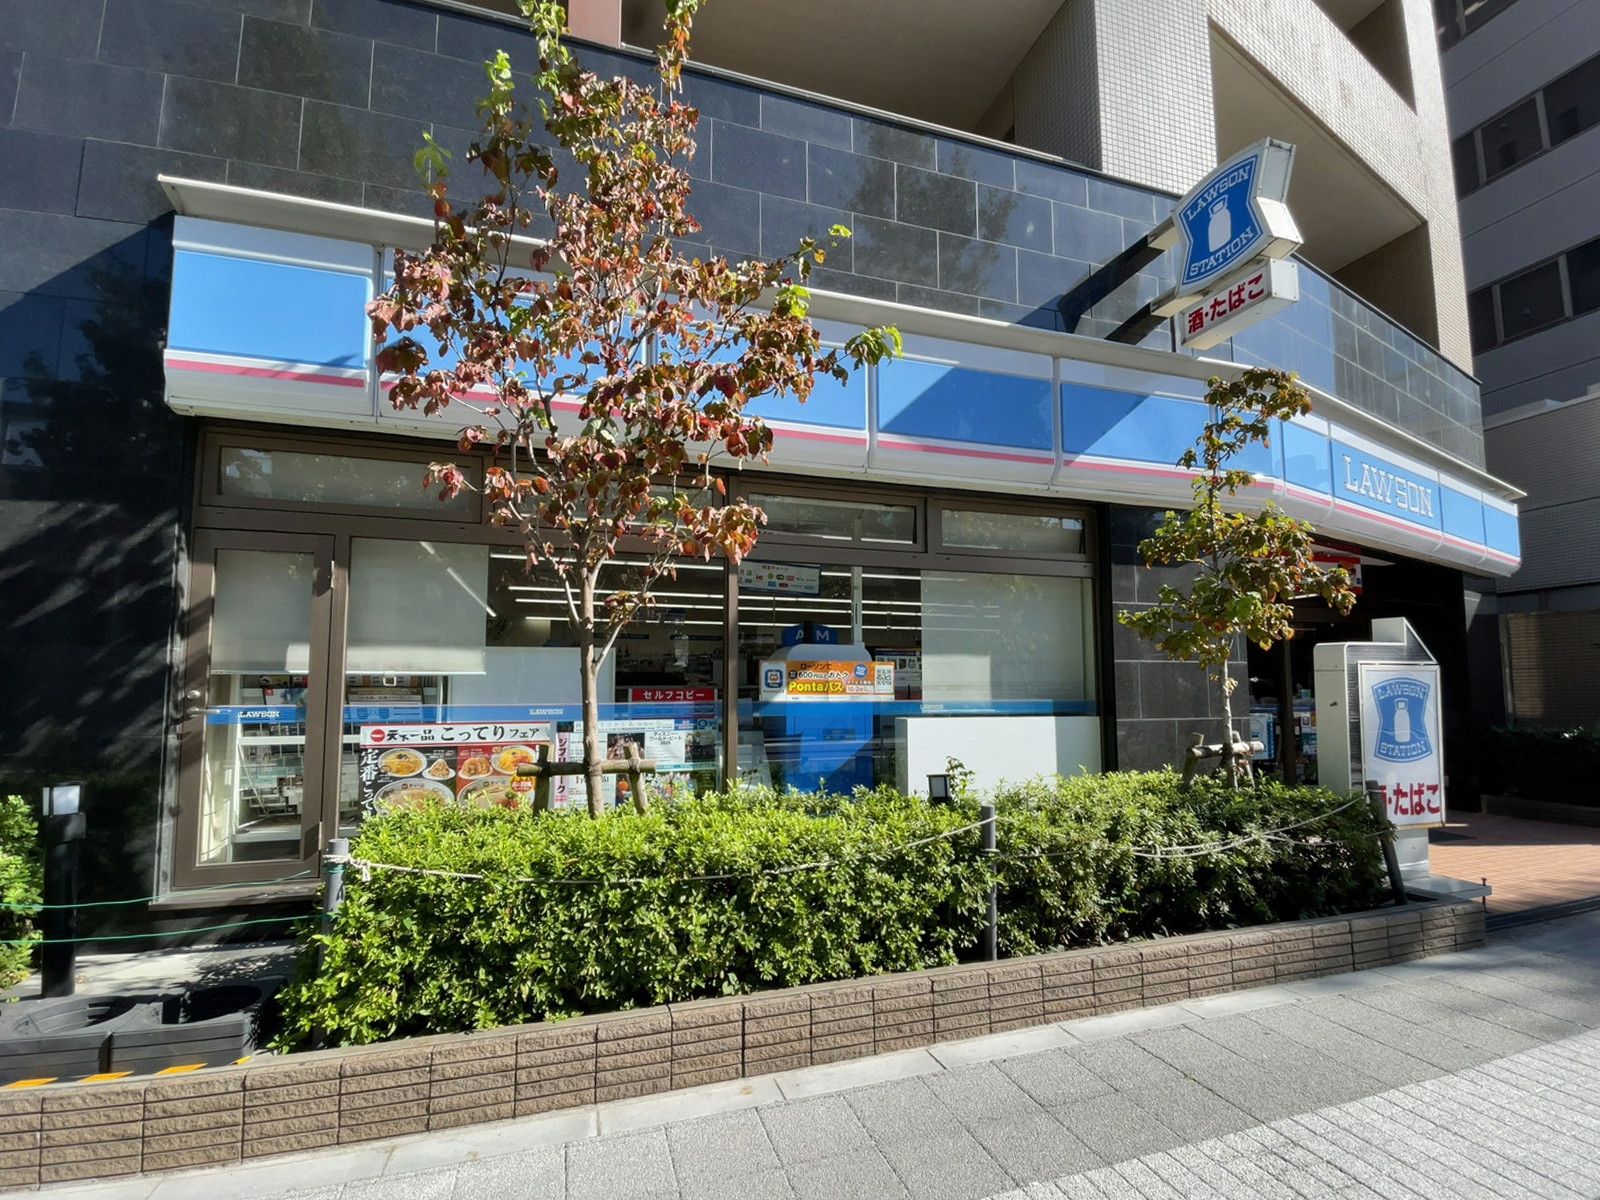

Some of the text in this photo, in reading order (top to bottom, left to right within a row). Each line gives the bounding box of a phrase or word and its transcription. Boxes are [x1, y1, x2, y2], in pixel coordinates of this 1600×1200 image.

[1186, 165, 1251, 221] LAWSON
[1189, 225, 1255, 276] STATION
[1187, 273, 1264, 334] 酒・たばこ
[1342, 454, 1433, 519] LAWSON
[643, 690, 705, 700] セルフコピー
[788, 681, 844, 692] Pontaパス
[1378, 683, 1427, 700] LAWSON
[239, 710, 280, 718] LAWSON
[529, 708, 564, 716] LAWSON
[1379, 740, 1427, 758] STATION
[557, 738, 567, 794] ジブリーク
